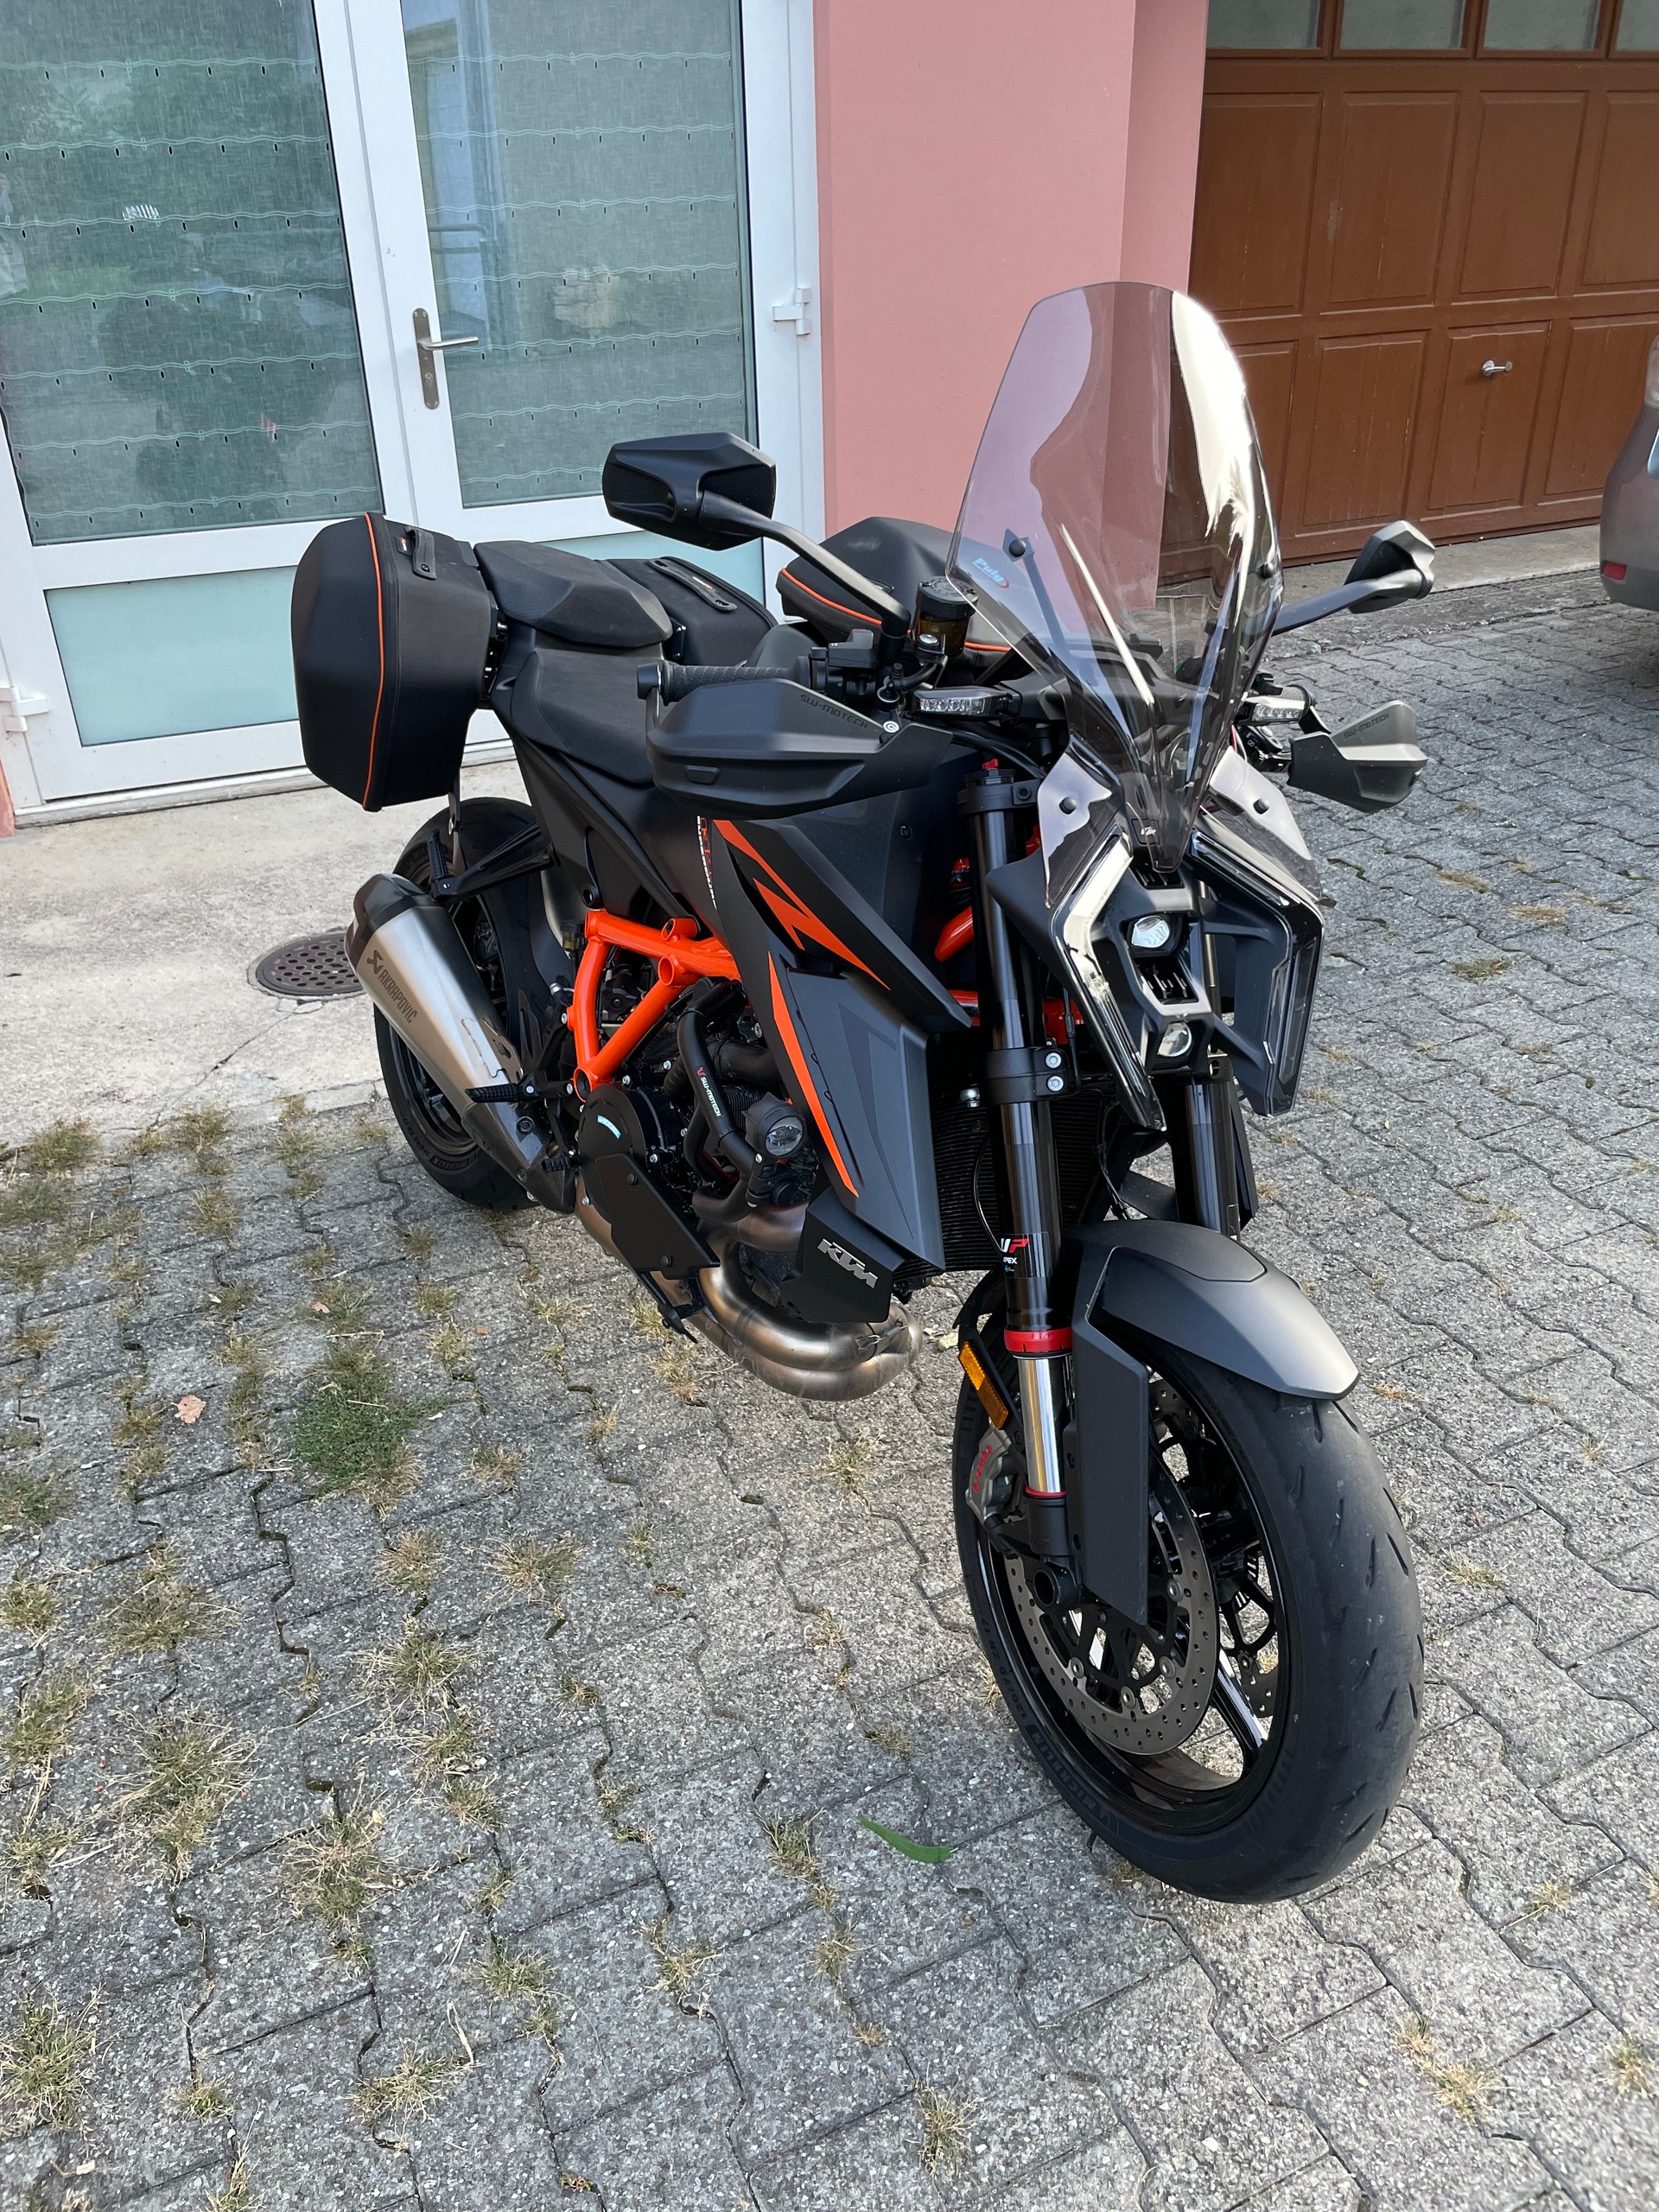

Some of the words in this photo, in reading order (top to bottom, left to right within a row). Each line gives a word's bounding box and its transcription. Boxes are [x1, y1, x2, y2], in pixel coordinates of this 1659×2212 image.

[972, 557, 1005, 583] Puig
[798, 694, 868, 729] SW-MOTECH
[1343, 712, 1389, 740] SW-MOTECH
[700, 1076, 722, 1117] SW-MOTECH
[817, 1238, 879, 1289] KTM
[1031, 1731, 1096, 1810] MICHELIN
